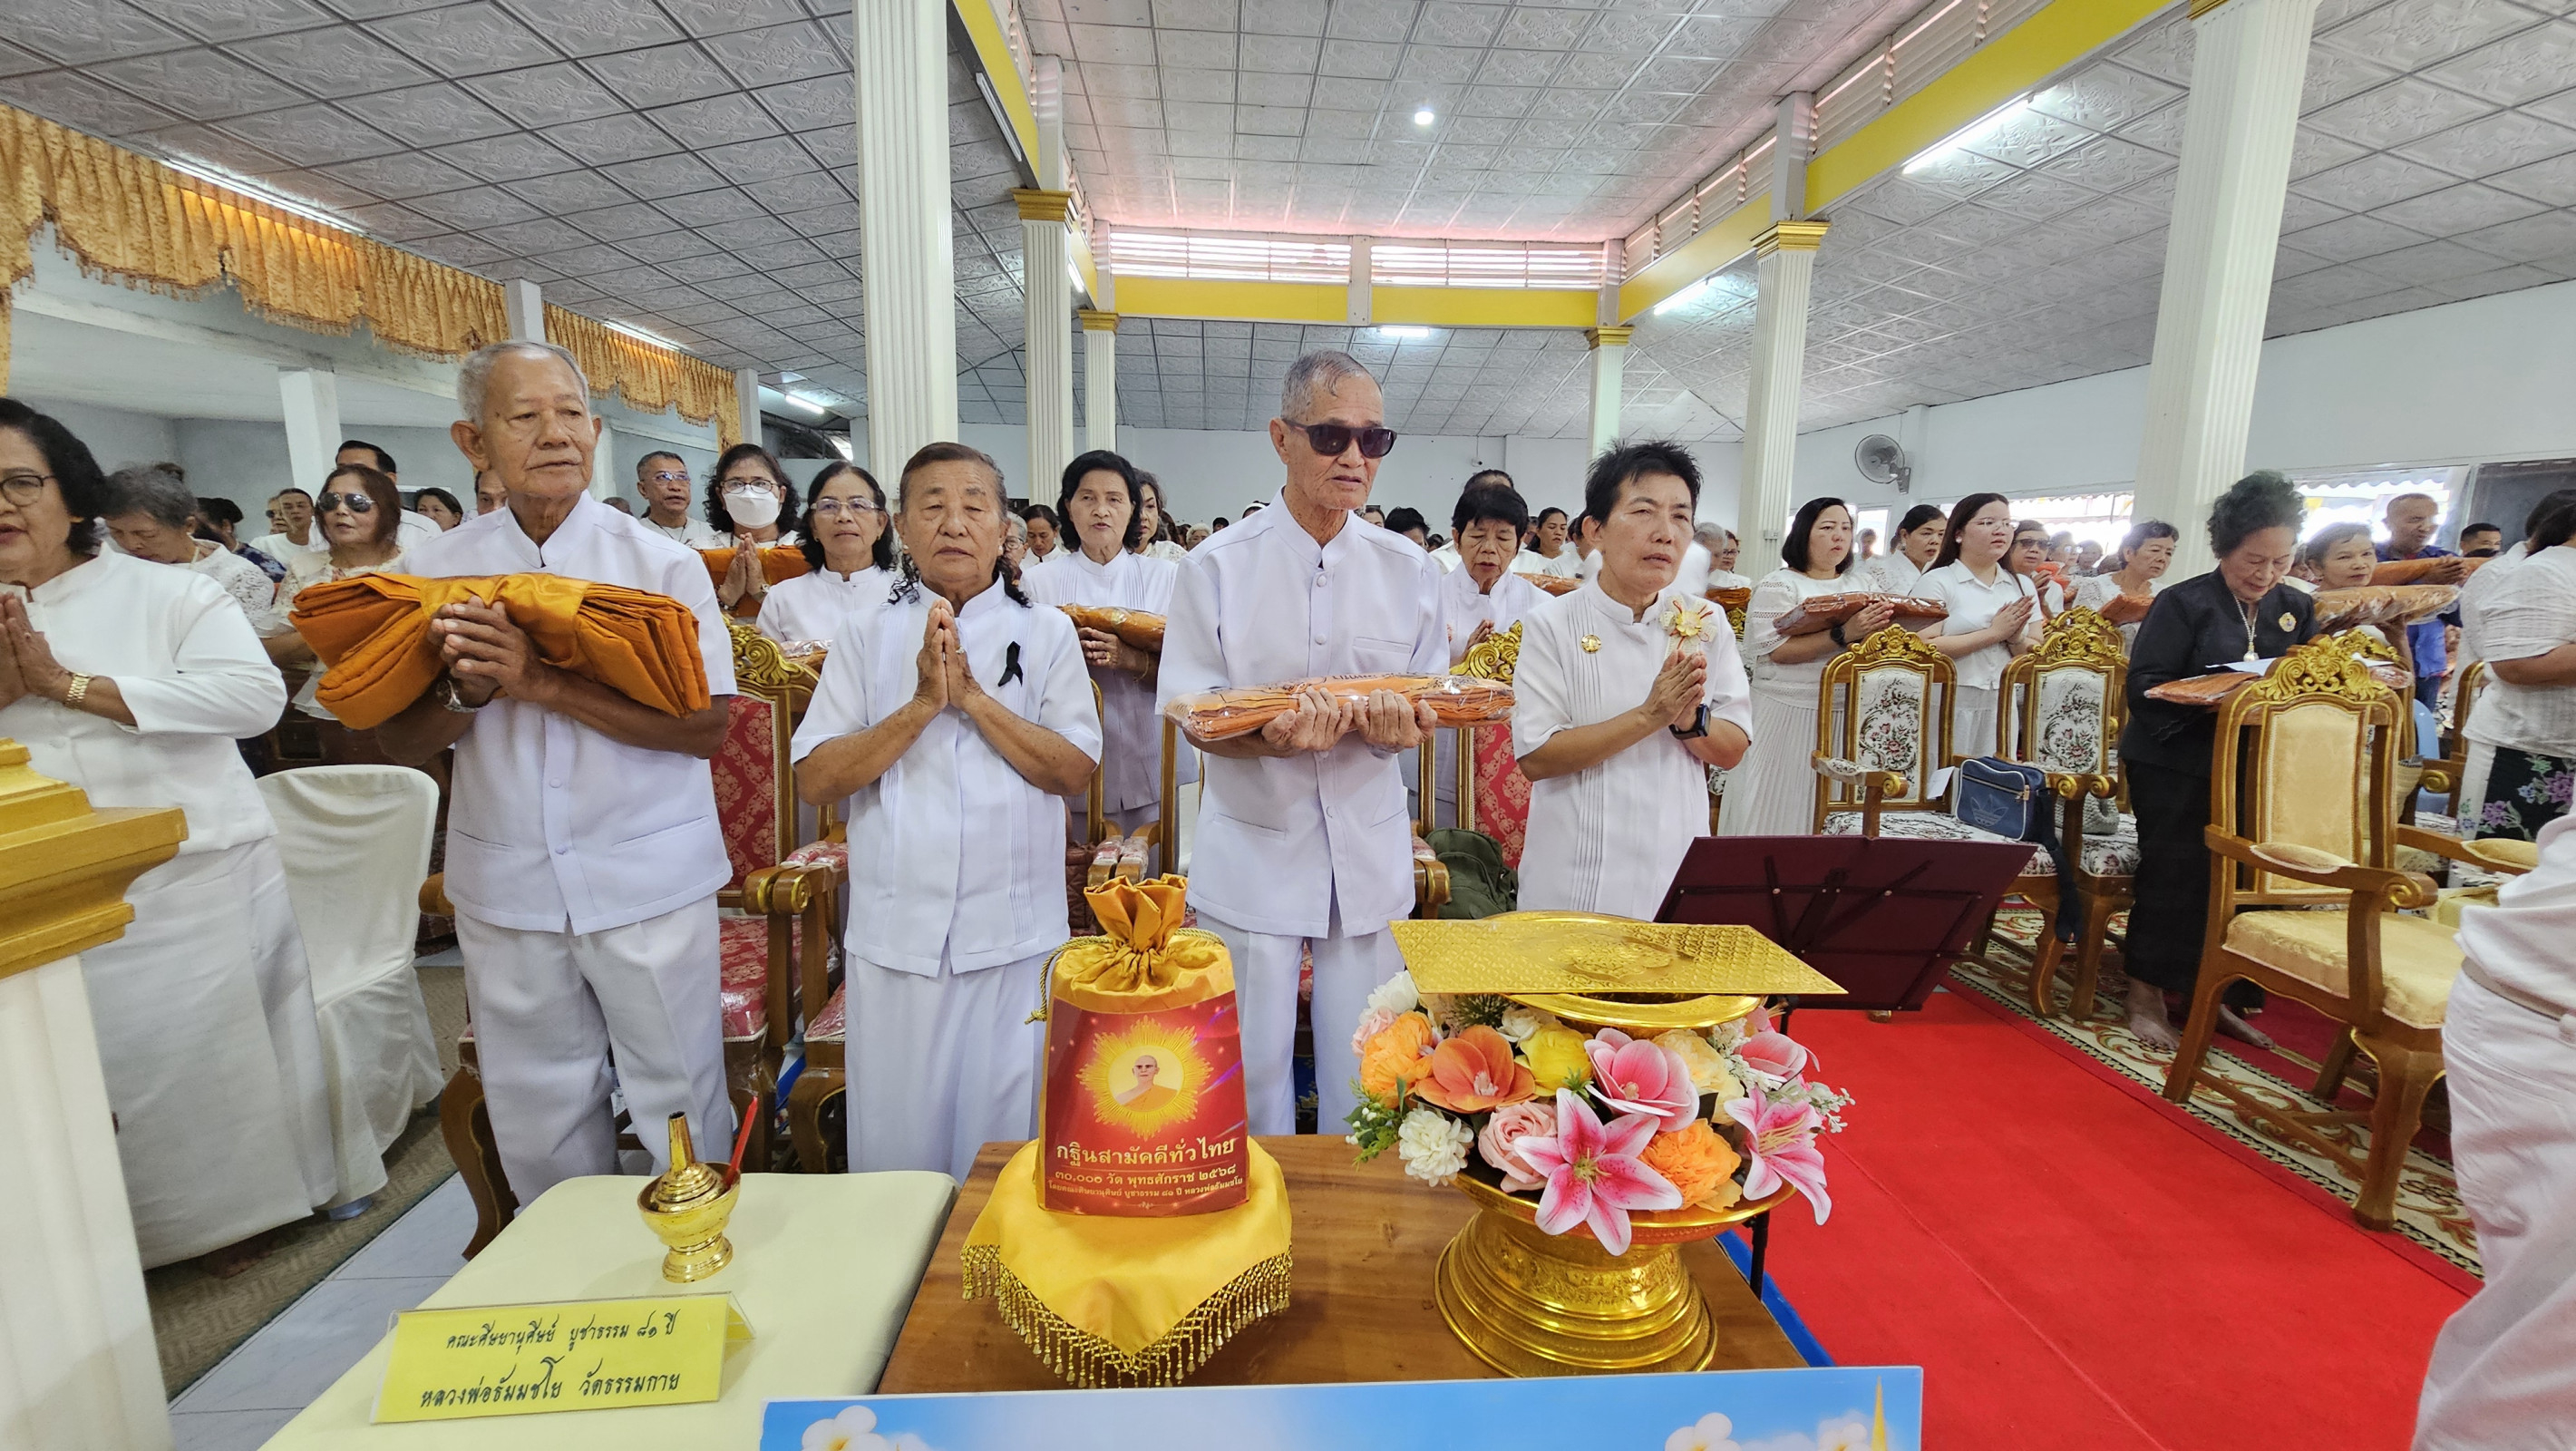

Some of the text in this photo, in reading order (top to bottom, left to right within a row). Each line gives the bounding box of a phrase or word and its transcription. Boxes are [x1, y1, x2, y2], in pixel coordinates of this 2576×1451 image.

[1056, 1136, 1235, 1167] กฐินสามัคคีทั่วไทย
[1106, 1172, 1123, 1184] วัด
[1127, 1172, 1194, 1188] พุทธศักราช
[1199, 1164, 1236, 1181] ๒๕๖๘
[1124, 1189, 1160, 1199] บูชาธรรม
[1176, 1186, 1182, 1196] ปี
[446, 1309, 681, 1355] คณะศิษยานุศิษย์ บูชาธรรม ๘๑ ปี
[421, 1356, 680, 1407] หลวงพ่อธัมมชโย วัดธรรมกาย
